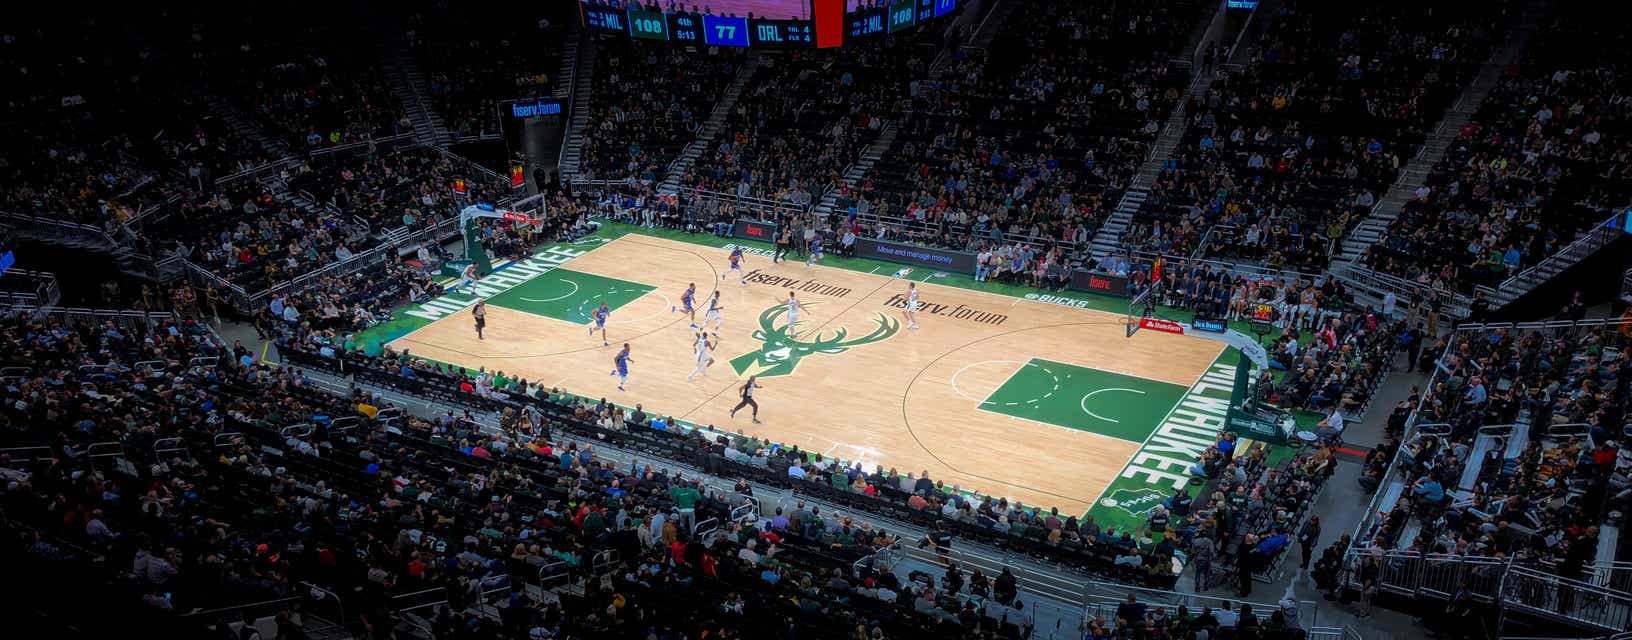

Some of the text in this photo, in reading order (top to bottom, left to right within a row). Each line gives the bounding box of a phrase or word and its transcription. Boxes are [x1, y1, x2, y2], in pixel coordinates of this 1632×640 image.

[606, 13, 623, 30] MIL
[678, 17, 692, 26] 4th
[868, 15, 883, 33] MIL
[893, 8, 911, 25] 108
[635, 18, 661, 33] 108
[715, 25, 736, 39] 77
[758, 24, 783, 41] ORL
[907, 251, 931, 261] manage
[931, 254, 953, 264] money
[743, 269, 852, 298] fiserv.forum
[1024, 293, 1089, 308] @BUCKS
[1121, 363, 1237, 492] MILWAUKEE
